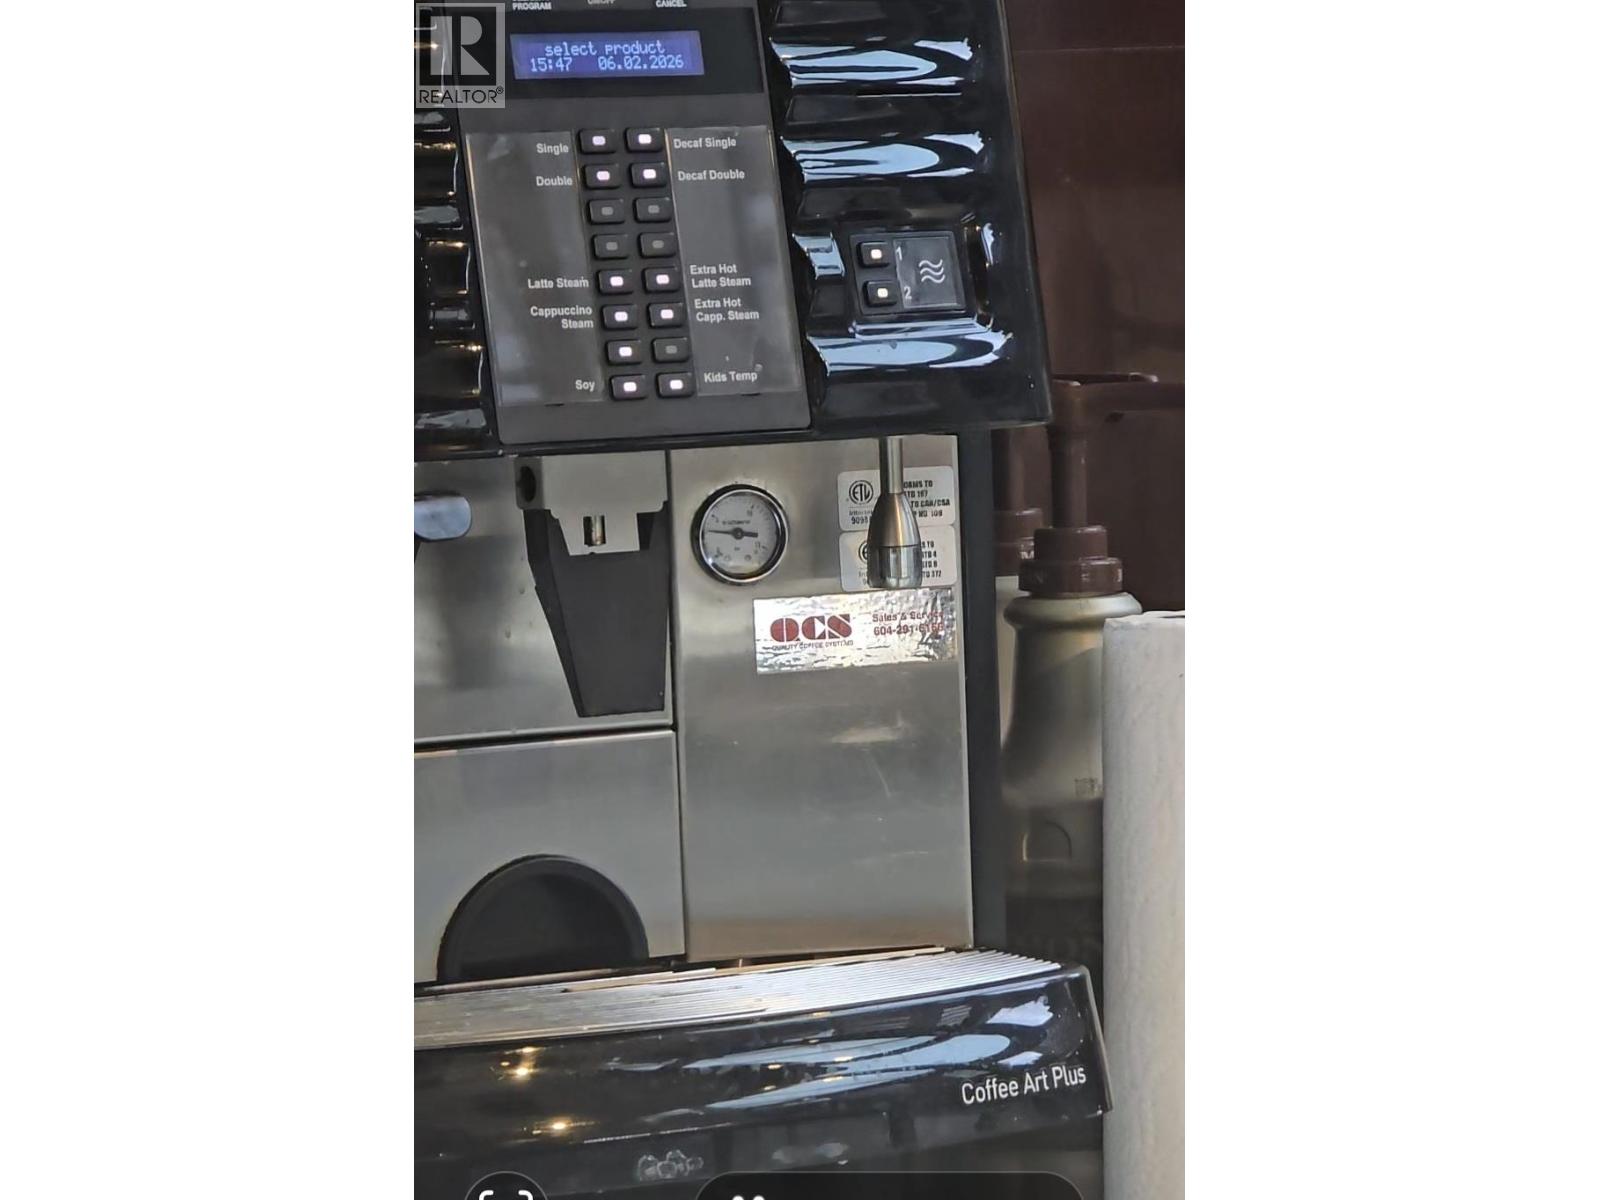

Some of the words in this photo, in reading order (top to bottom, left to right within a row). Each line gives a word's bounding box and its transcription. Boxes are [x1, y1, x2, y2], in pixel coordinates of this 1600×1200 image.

[512, 2, 552, 11] PROGRAM
[655, 0, 687, 8] CANCEL
[544, 42, 597, 57] select
[605, 40, 666, 56] product
[530, 57, 573, 73] 15:47
[598, 54, 684, 71] 06.02.2026
[536, 142, 570, 155] Single
[673, 138, 704, 150] Decaf
[705, 137, 737, 149] Single
[536, 175, 573, 187] Double
[678, 170, 708, 182] Decaf
[709, 169, 745, 181] Double
[896, 246, 903, 261] 1
[690, 264, 717, 276] Extra
[719, 263, 738, 275] Hot
[528, 278, 554, 289] Latte
[556, 276, 589, 289] Steam
[692, 277, 717, 289] Latte
[719, 276, 752, 288] Steam
[903, 285, 913, 301] 2
[694, 299, 719, 310] Extra
[721, 297, 742, 309] Hot
[530, 305, 593, 318] Cappuccino
[696, 313, 726, 325] Capp.
[727, 310, 760, 322] Steam
[561, 318, 594, 330] Steam
[704, 372, 727, 384] Kids
[728, 371, 758, 384] Temp
[575, 379, 595, 393] Soy
[961, 1077, 1019, 1104] Coffee
[1023, 1071, 1050, 1094] Art
[1052, 1065, 1086, 1089] Plus
